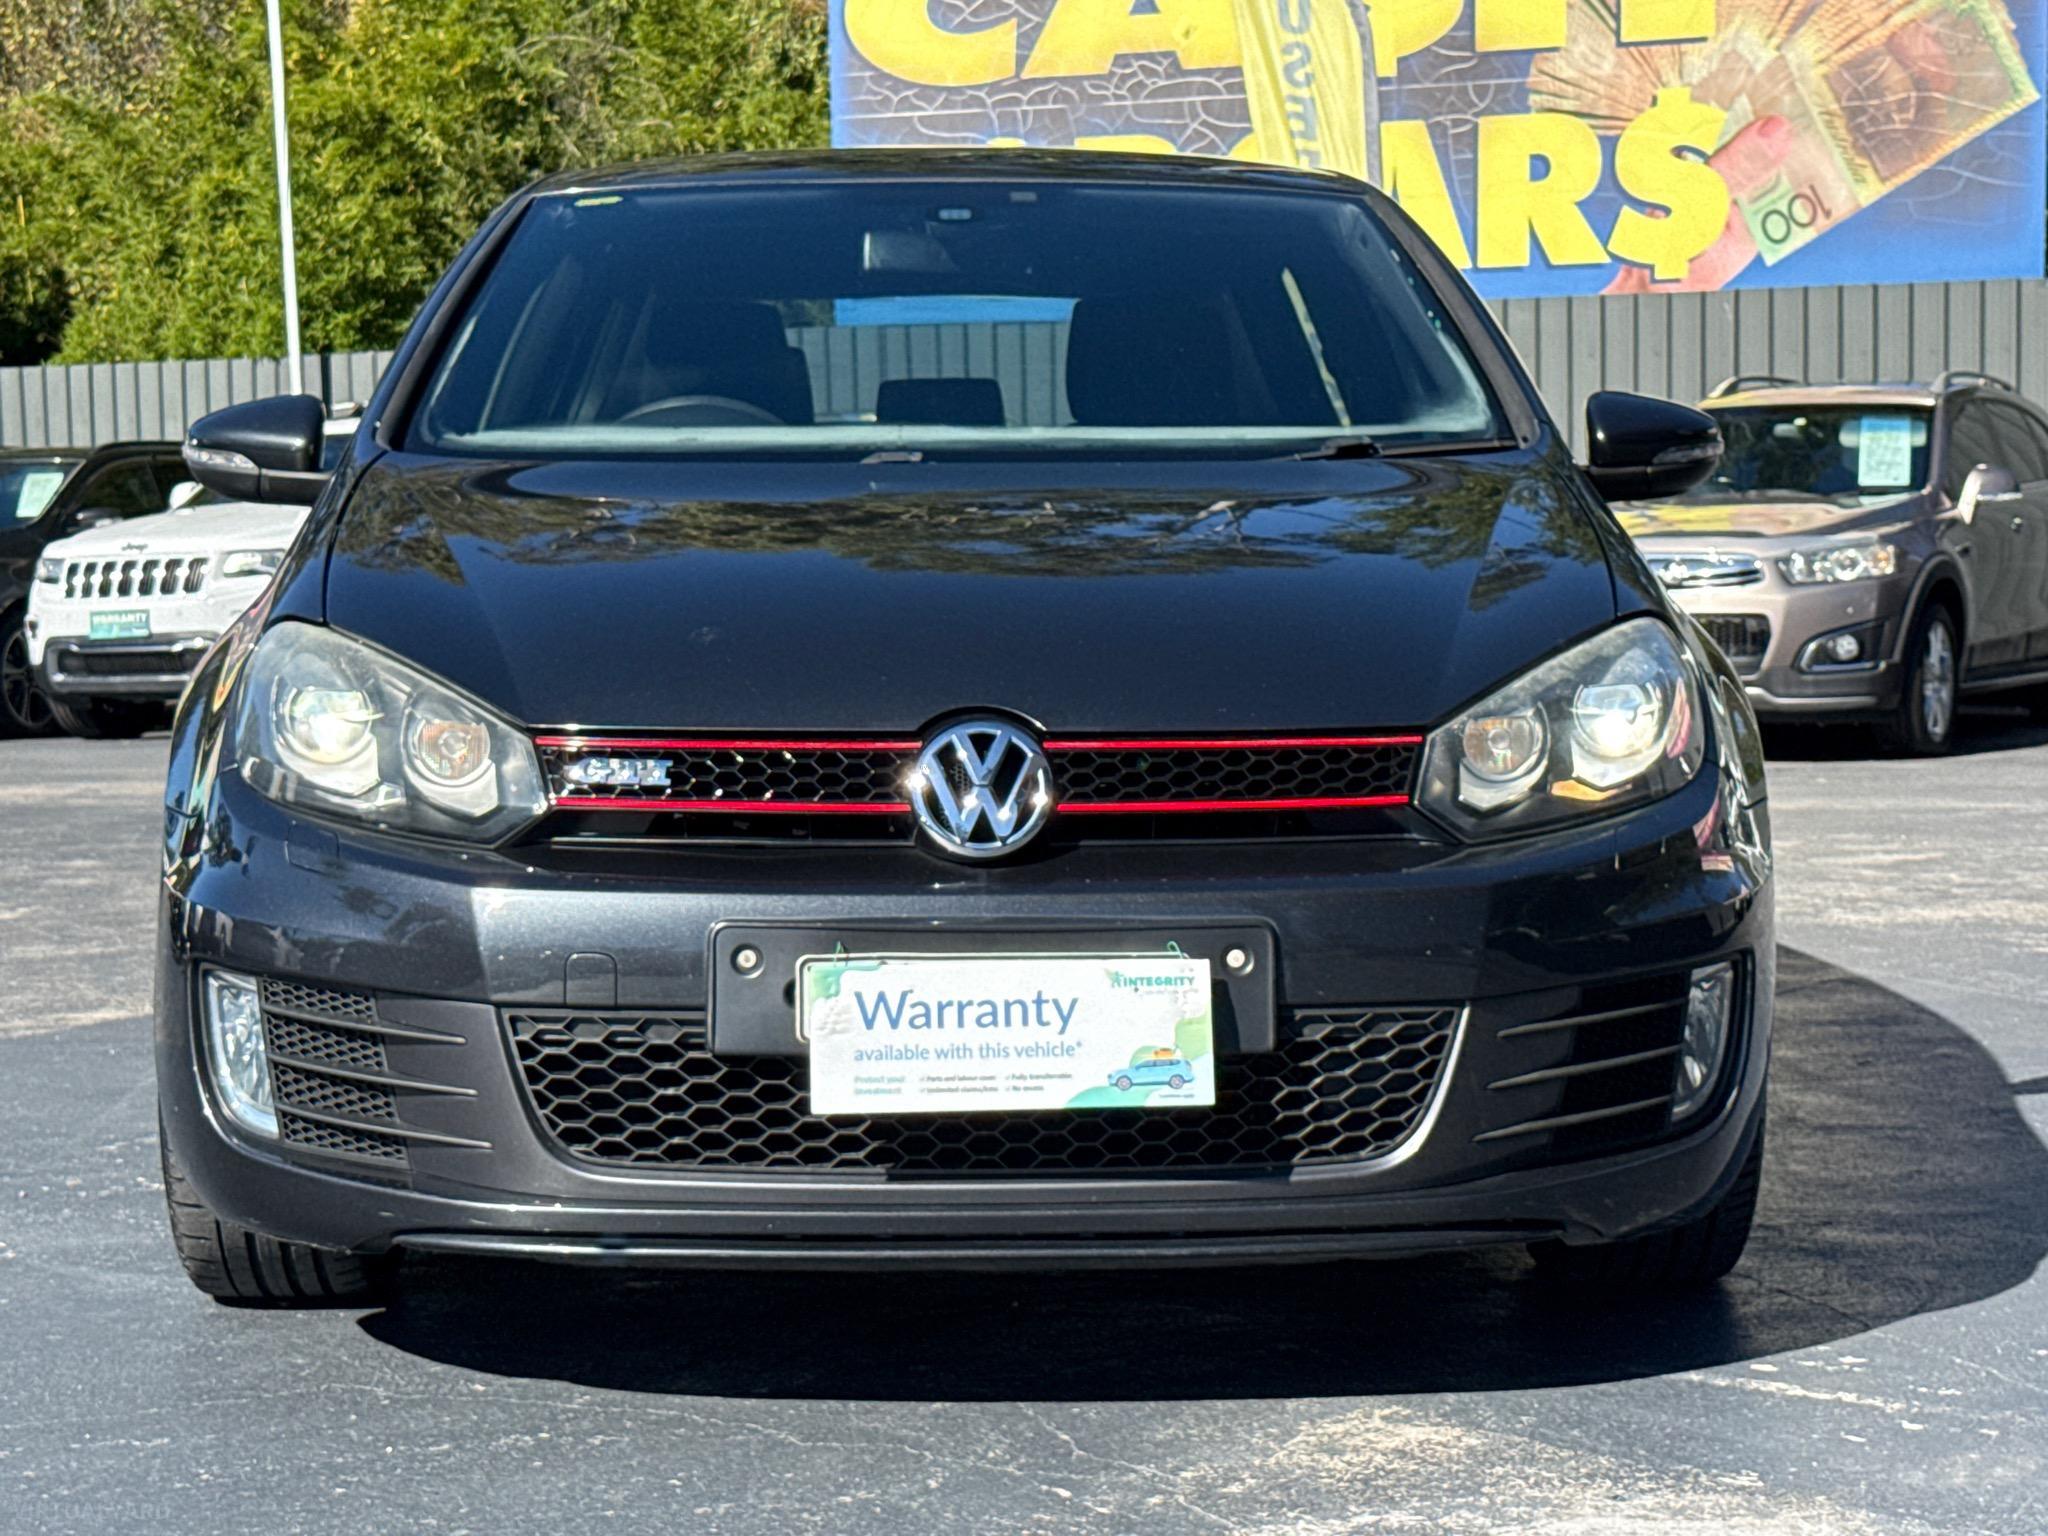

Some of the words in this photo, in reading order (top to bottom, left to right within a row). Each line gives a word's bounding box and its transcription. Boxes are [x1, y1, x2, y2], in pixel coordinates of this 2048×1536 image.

[1762, 184, 1832, 244] 100
[1124, 976, 1195, 987] INTEGRITY
[854, 989, 1080, 1036] Warranty
[854, 1043, 930, 1061] available
[935, 1042, 974, 1060] with
[979, 1041, 1010, 1059] this
